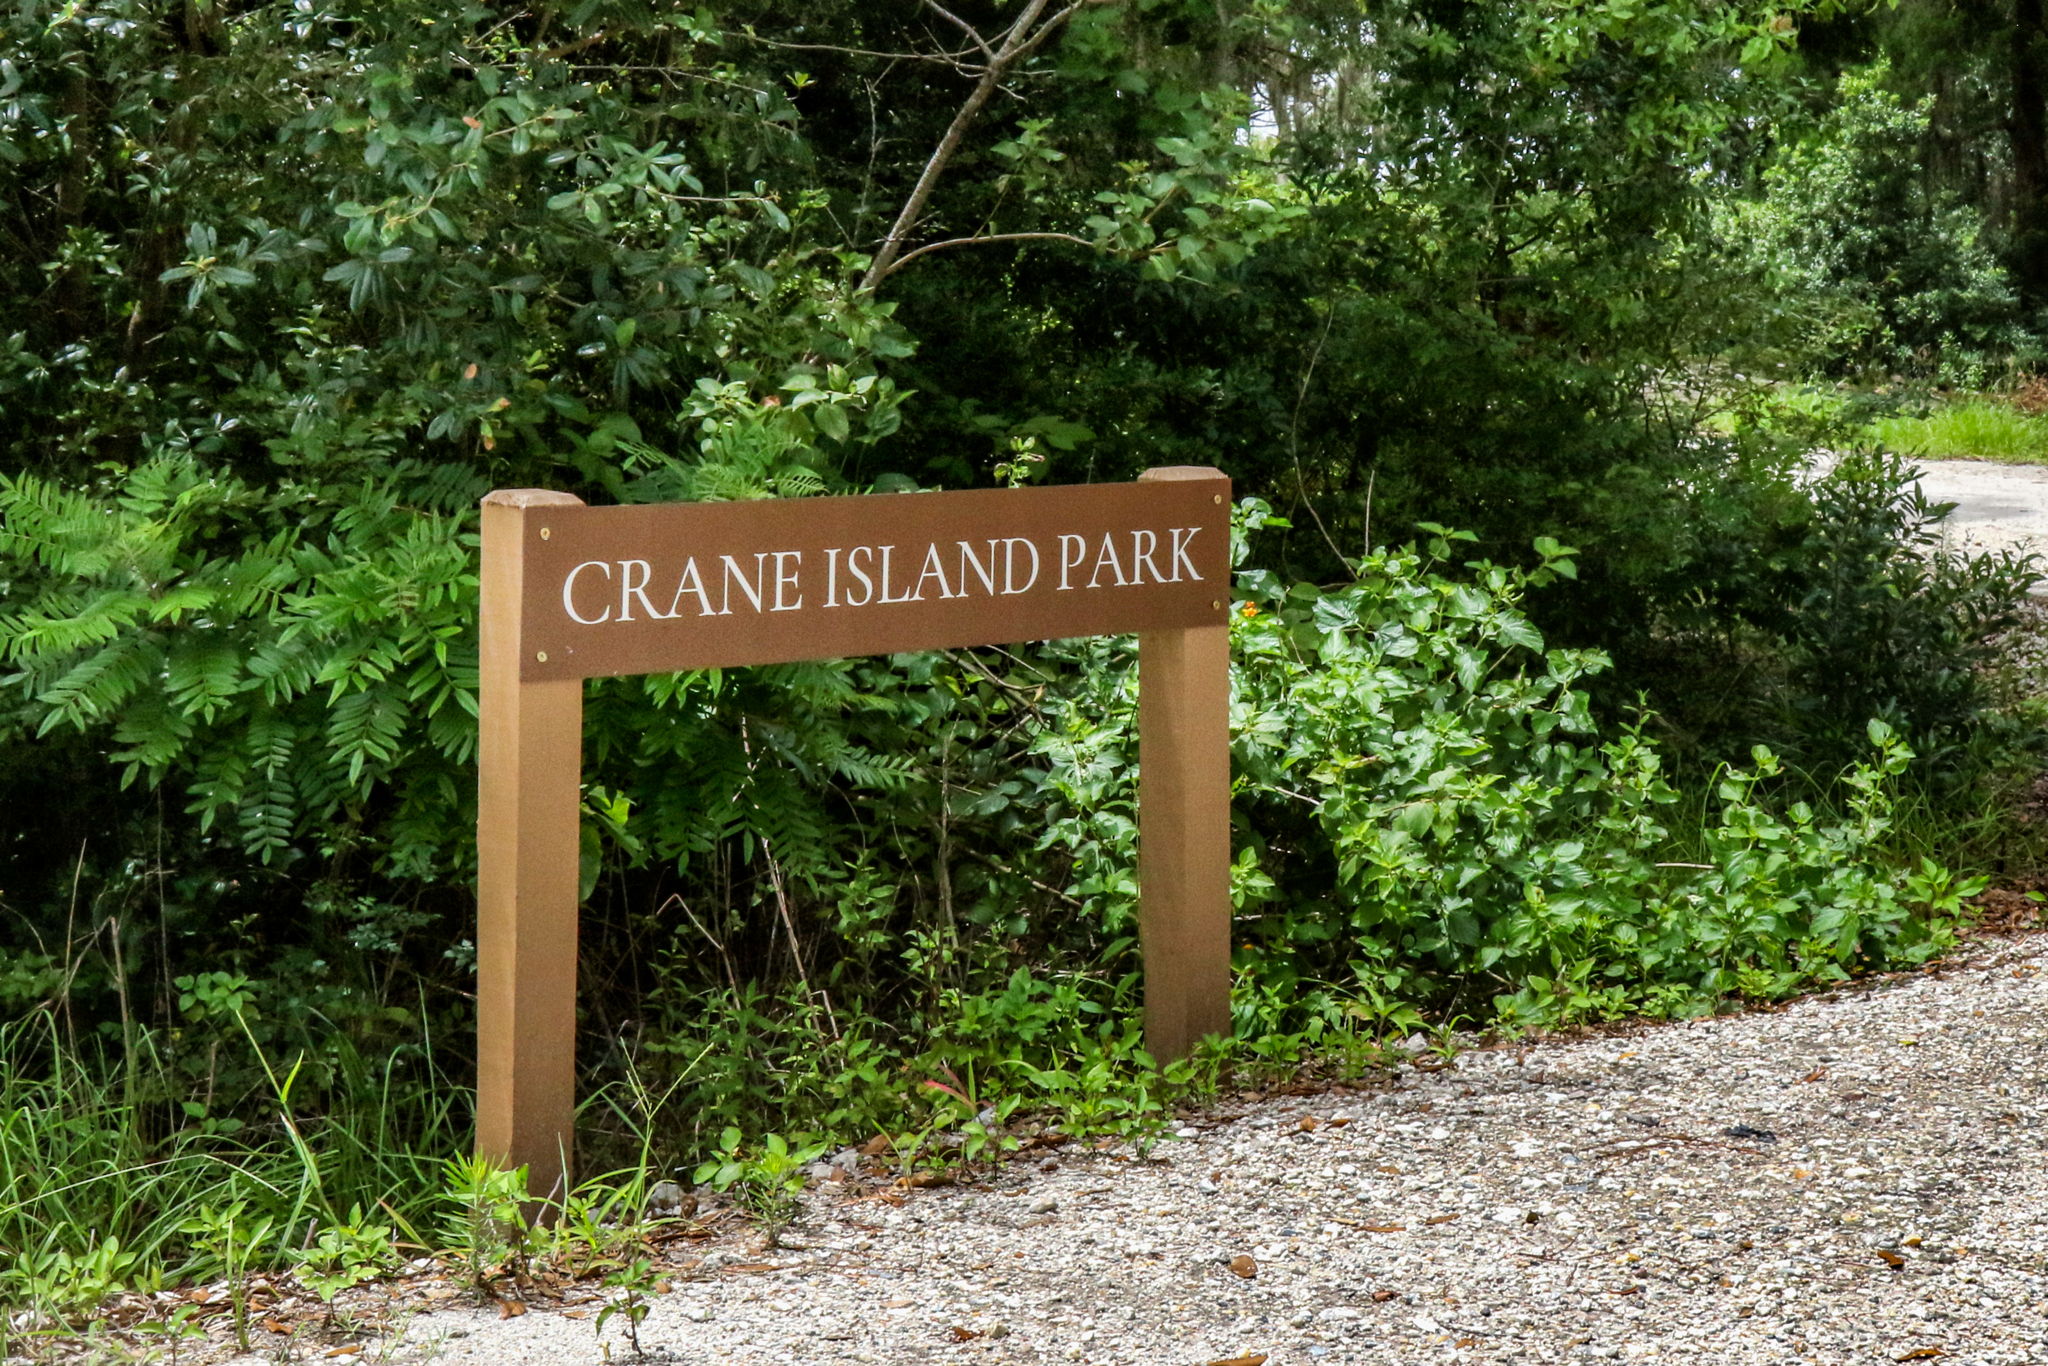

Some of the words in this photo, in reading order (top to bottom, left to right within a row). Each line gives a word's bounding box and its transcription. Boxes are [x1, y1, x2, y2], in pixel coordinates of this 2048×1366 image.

[562, 550, 803, 625] CRANE
[822, 537, 1040, 608] ISLAND
[1056, 527, 1205, 591] PARK
